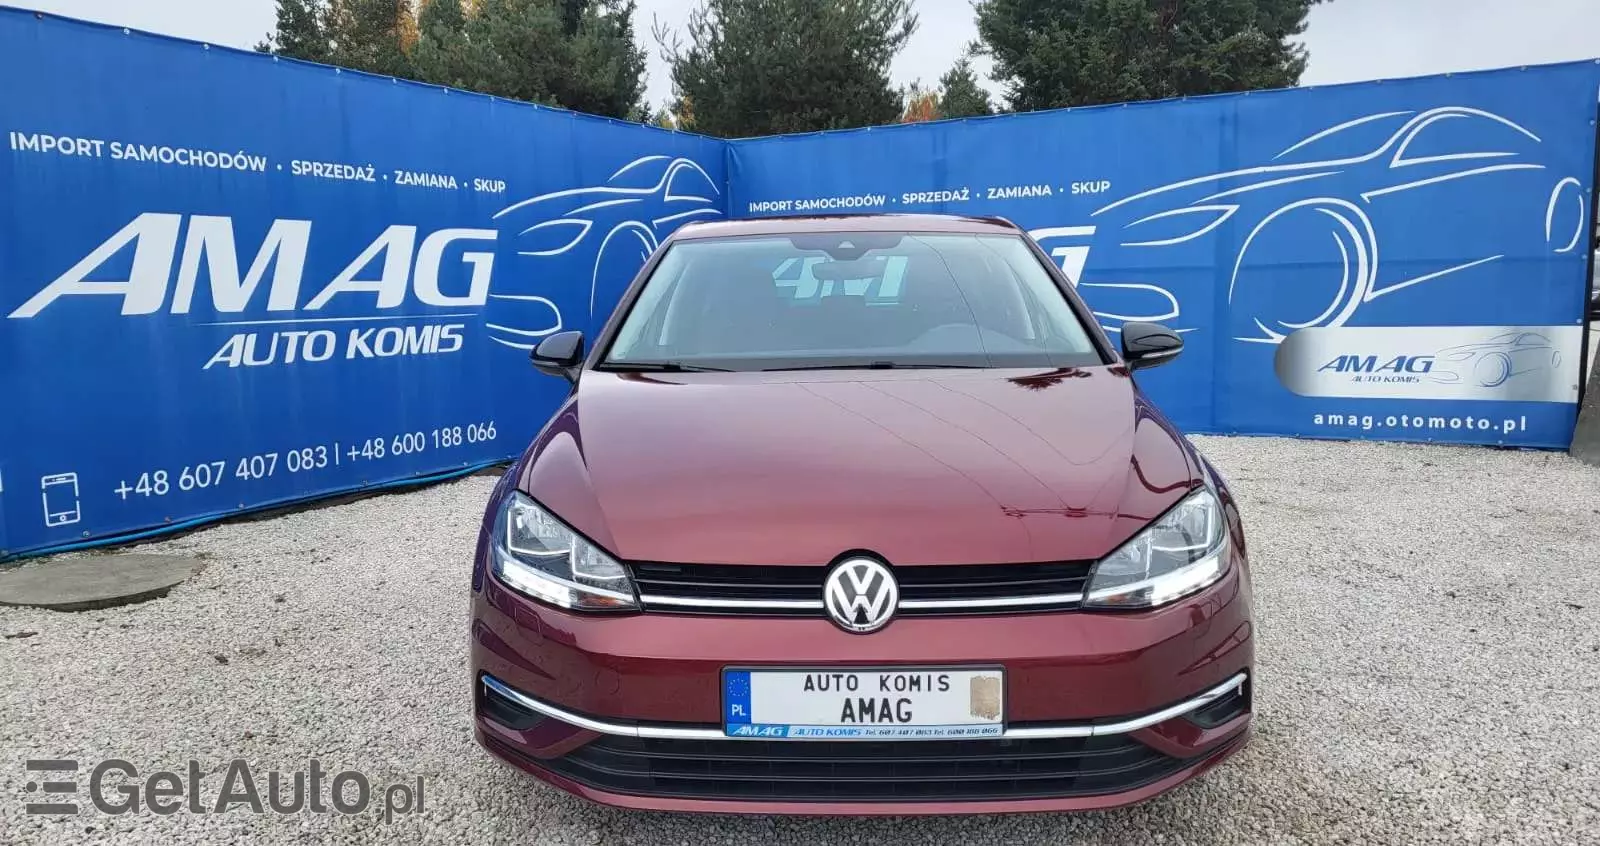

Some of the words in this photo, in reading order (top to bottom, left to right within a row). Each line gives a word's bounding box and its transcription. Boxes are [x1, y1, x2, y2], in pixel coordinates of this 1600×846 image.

[9, 131, 105, 158] IMPORT
[110, 141, 267, 172] SAMOCHODÓW
[291, 159, 376, 182] SPRZEDAŻ
[394, 170, 458, 190] ZAMIANA
[473, 178, 506, 193] SKUP
[749, 201, 793, 212] IMPORT
[794, 194, 886, 210] SAMOCHODÓW
[902, 187, 970, 204] SPRZEDAŻ
[987, 184, 1052, 199] ZAMIANA
[1071, 180, 1111, 194] SKUP
[203, 328, 336, 370] AUTO
[346, 324, 465, 359] KOMIS
[1313, 413, 1527, 434] amag.otomoto.pl
[114, 470, 170, 500] +48
[178, 461, 226, 491] 607
[235, 452, 279, 481] 407
[287, 445, 328, 473] 083
[347, 437, 385, 462] +48
[391, 431, 426, 456] 600
[431, 426, 462, 449] 188
[467, 420, 497, 443] 066
[803, 674, 859, 692] AUTO
[879, 674, 951, 692] KOMIS
[731, 704, 747, 717] PL
[840, 697, 913, 723] AMAG
